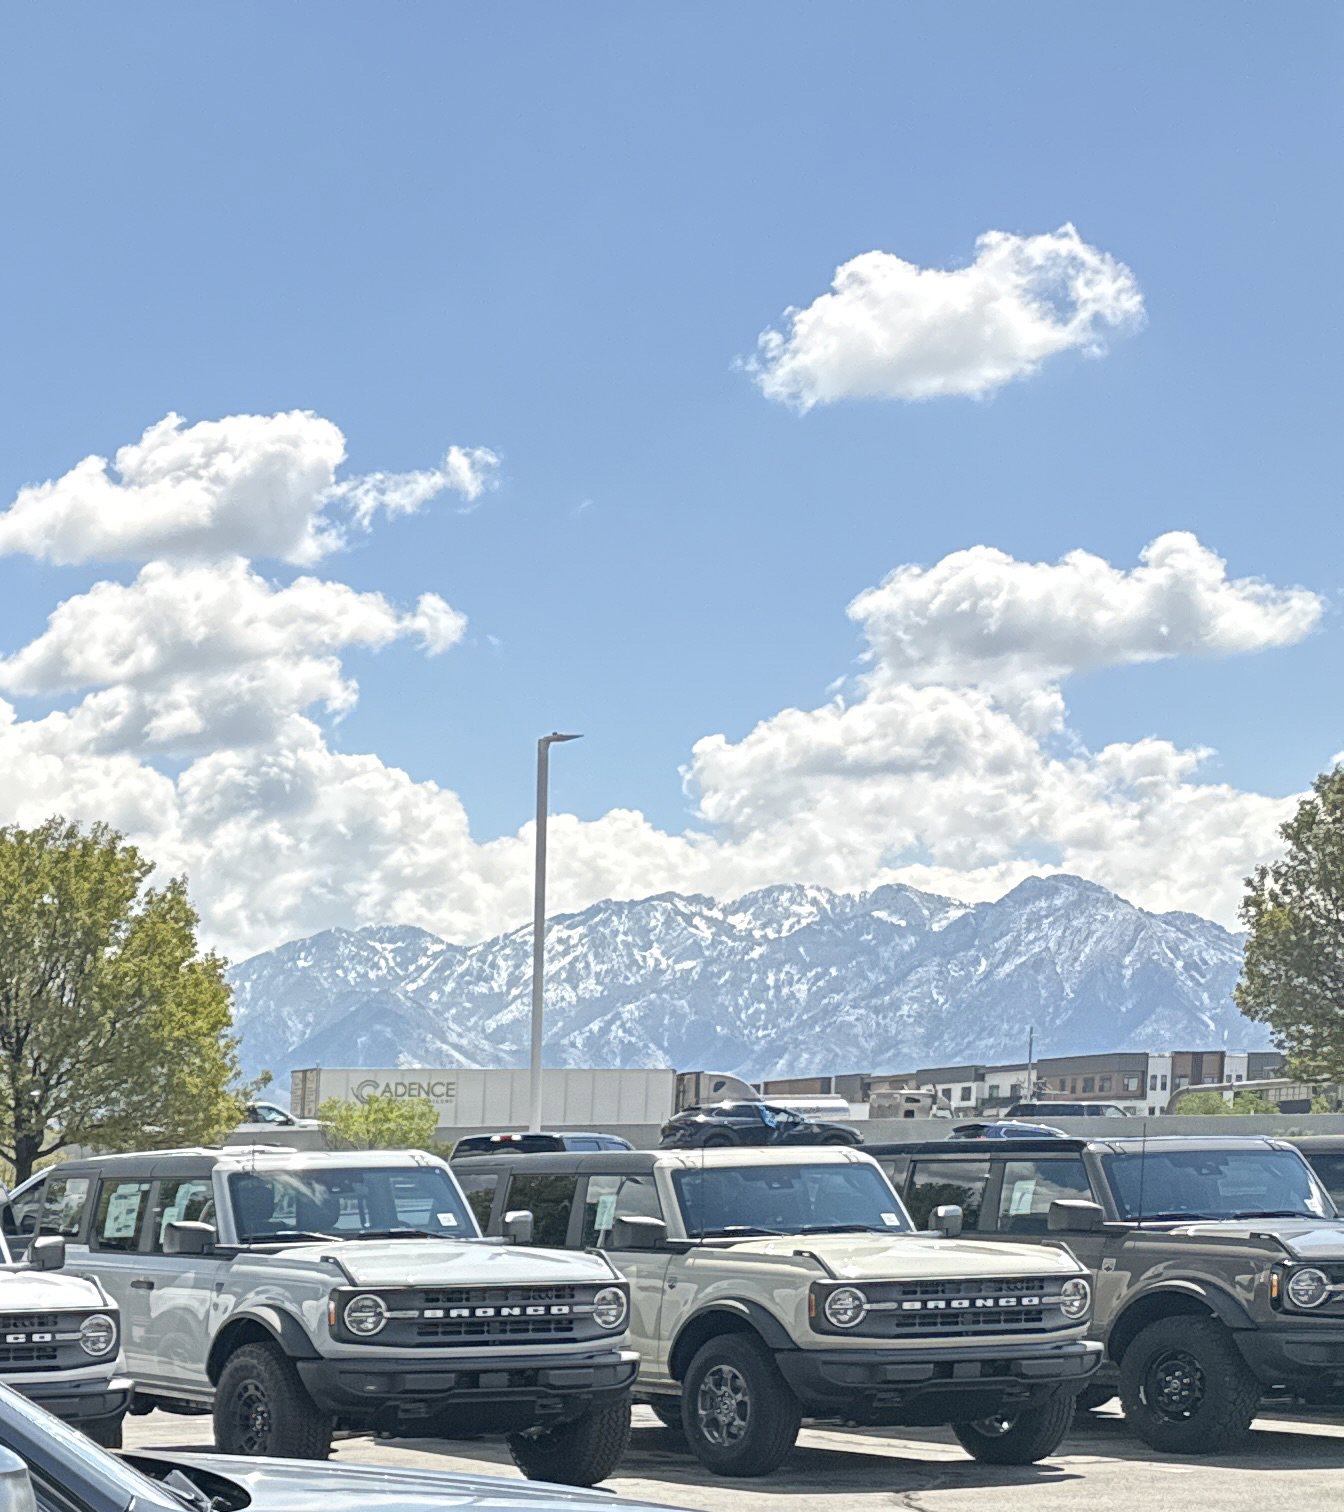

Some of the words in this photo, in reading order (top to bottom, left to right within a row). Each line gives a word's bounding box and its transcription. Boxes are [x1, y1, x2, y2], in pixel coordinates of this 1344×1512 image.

[350, 1080, 456, 1104] CADENCE
[901, 1296, 1040, 1310] BRONCO
[423, 1305, 570, 1319] BRONCO
